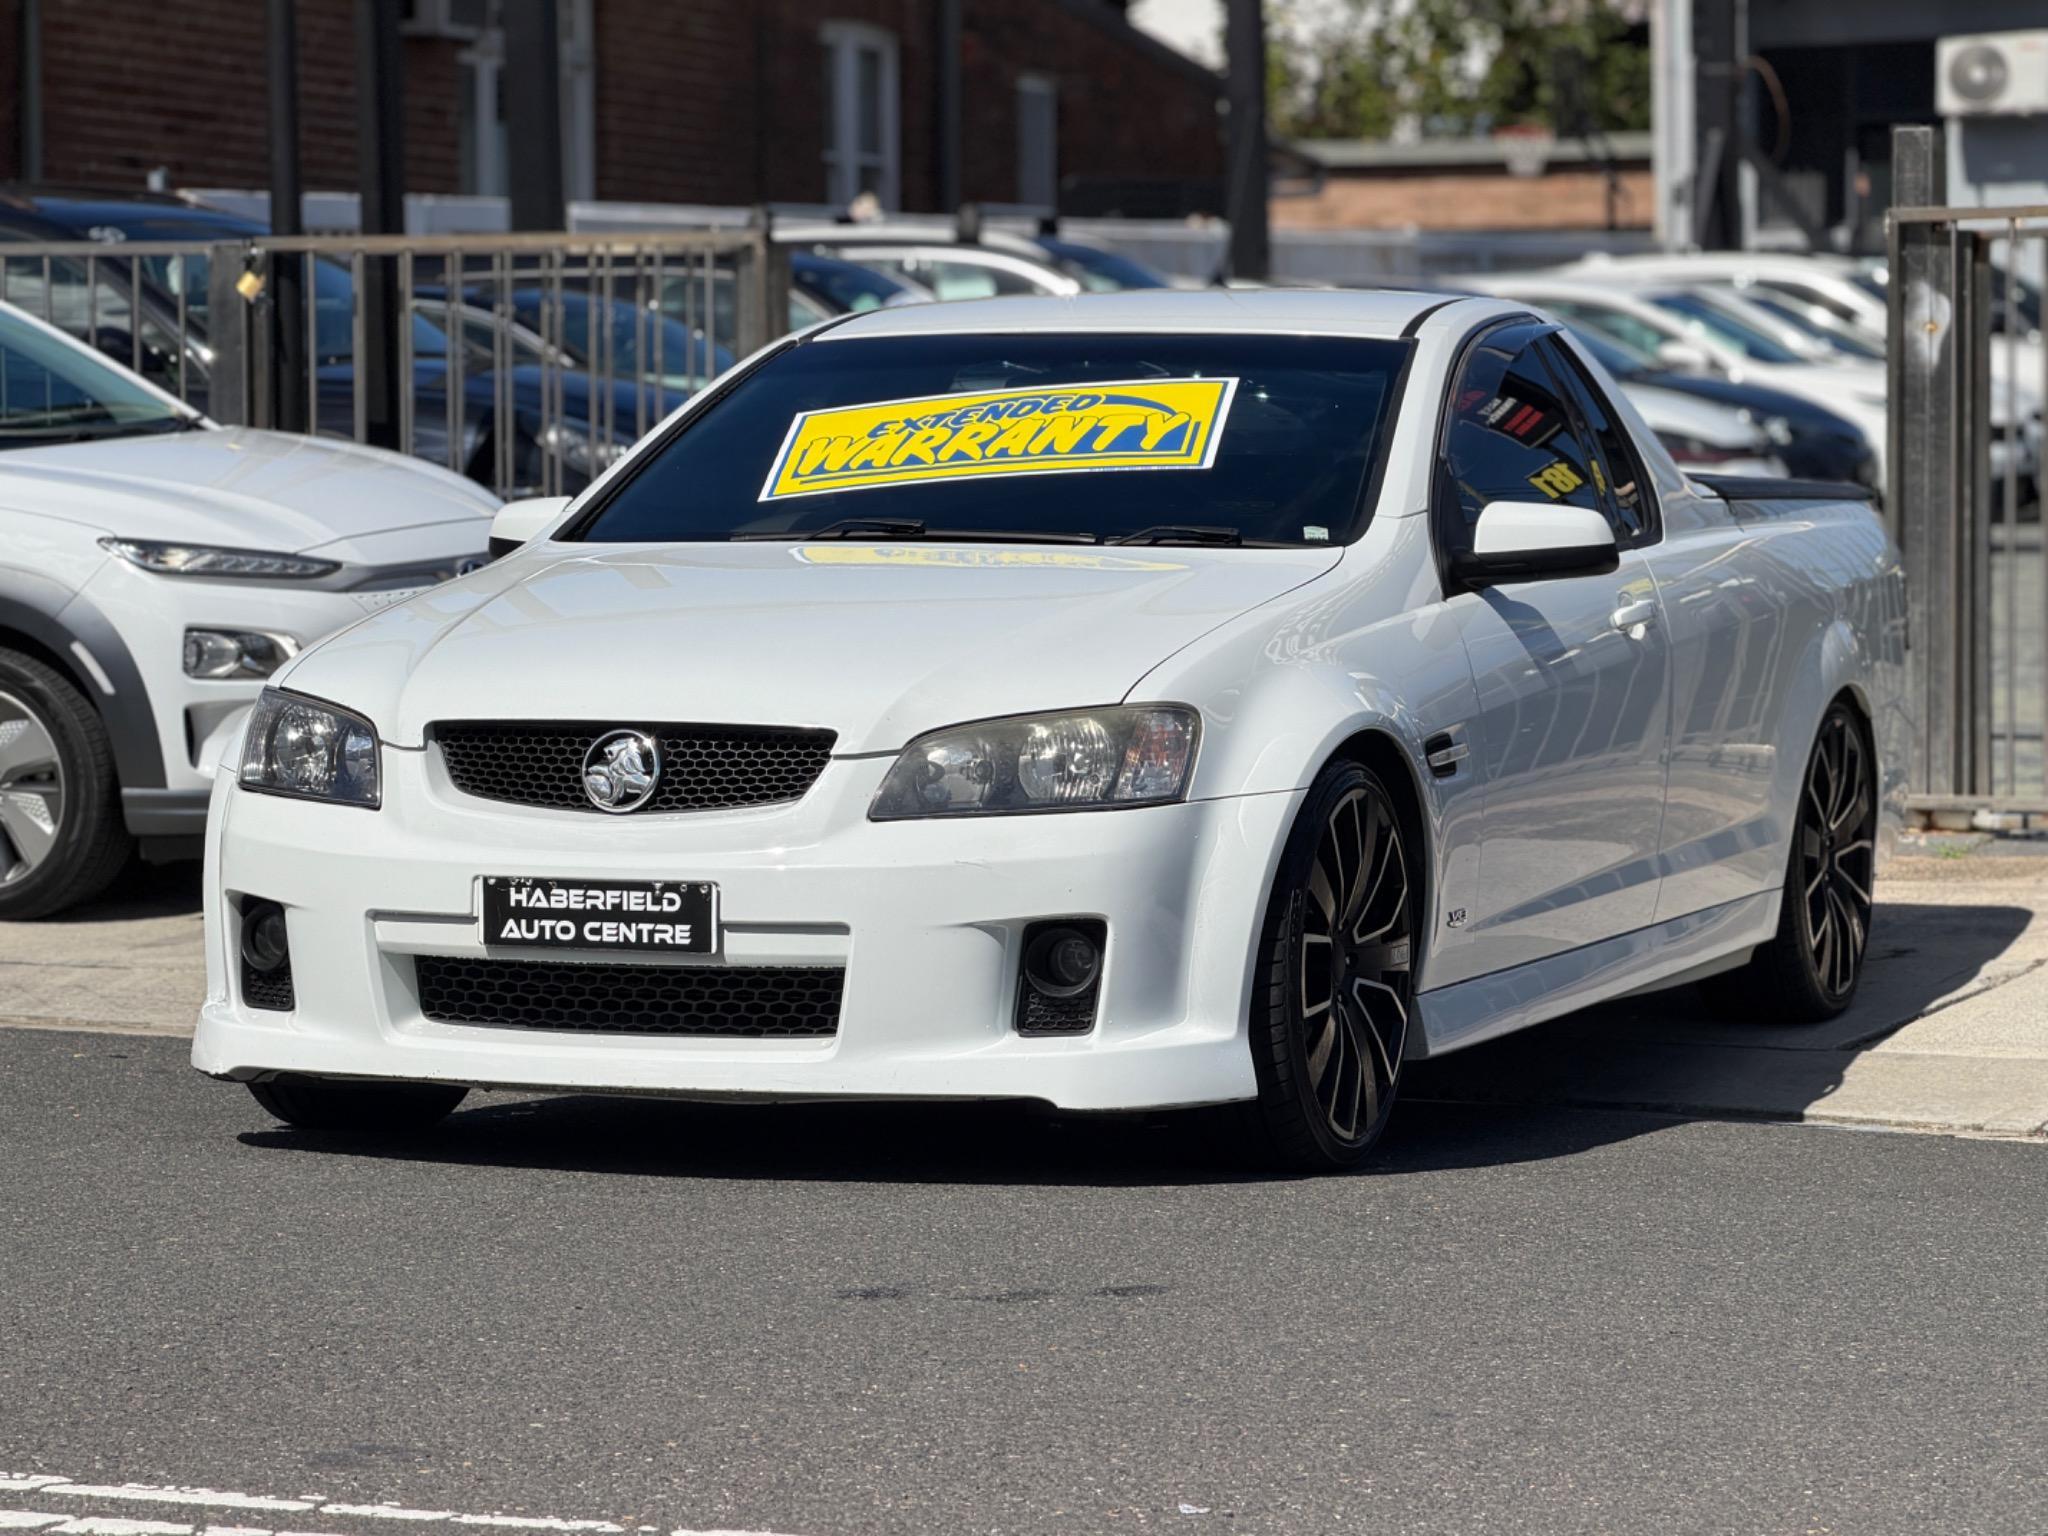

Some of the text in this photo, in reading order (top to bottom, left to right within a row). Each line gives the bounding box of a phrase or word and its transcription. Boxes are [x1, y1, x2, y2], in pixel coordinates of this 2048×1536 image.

[868, 393, 1104, 439] EXTENDED
[799, 413, 1189, 475] WARRANTY
[509, 887, 682, 912] HABERFIELD
[500, 918, 692, 945] AUTO CENTRE
